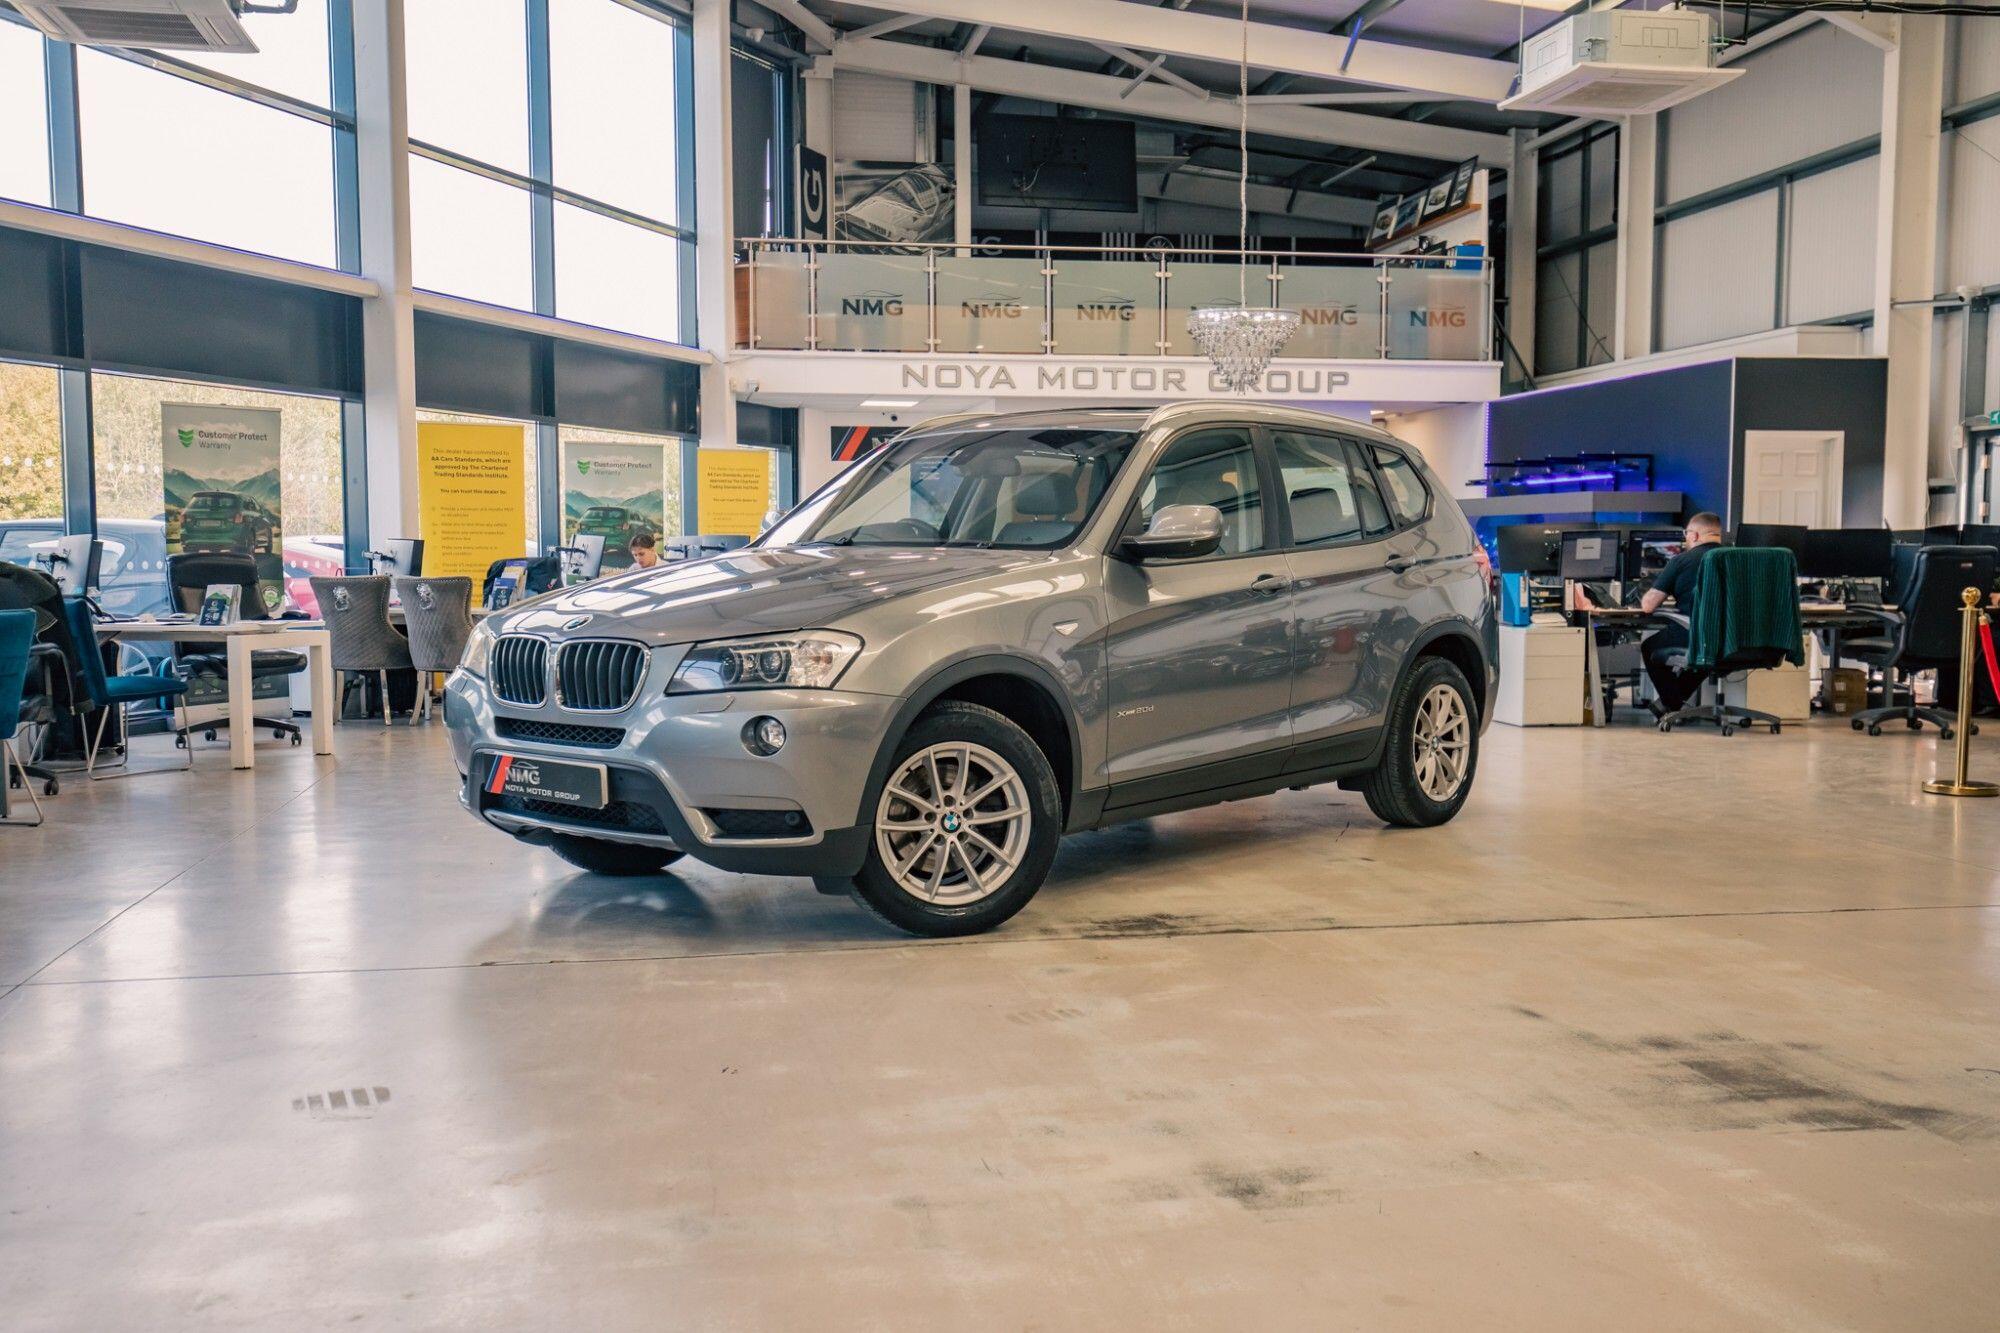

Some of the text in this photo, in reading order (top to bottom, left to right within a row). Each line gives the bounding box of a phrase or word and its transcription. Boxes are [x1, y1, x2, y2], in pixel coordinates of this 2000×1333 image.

[842, 298, 904, 316] NMG
[961, 301, 1022, 319] NMG
[1077, 304, 1136, 322] NMG
[1301, 308, 1358, 326] NMG
[1410, 309, 1466, 328] NMG
[902, 364, 1016, 390] NOYA
[1038, 366, 1187, 392] MOTOR
[198, 430, 268, 441] Customer Protect
[199, 441, 231, 450] Warranty
[505, 766, 540, 785] NMG
[505, 784, 581, 801] NOYA MOTOR GROUP
